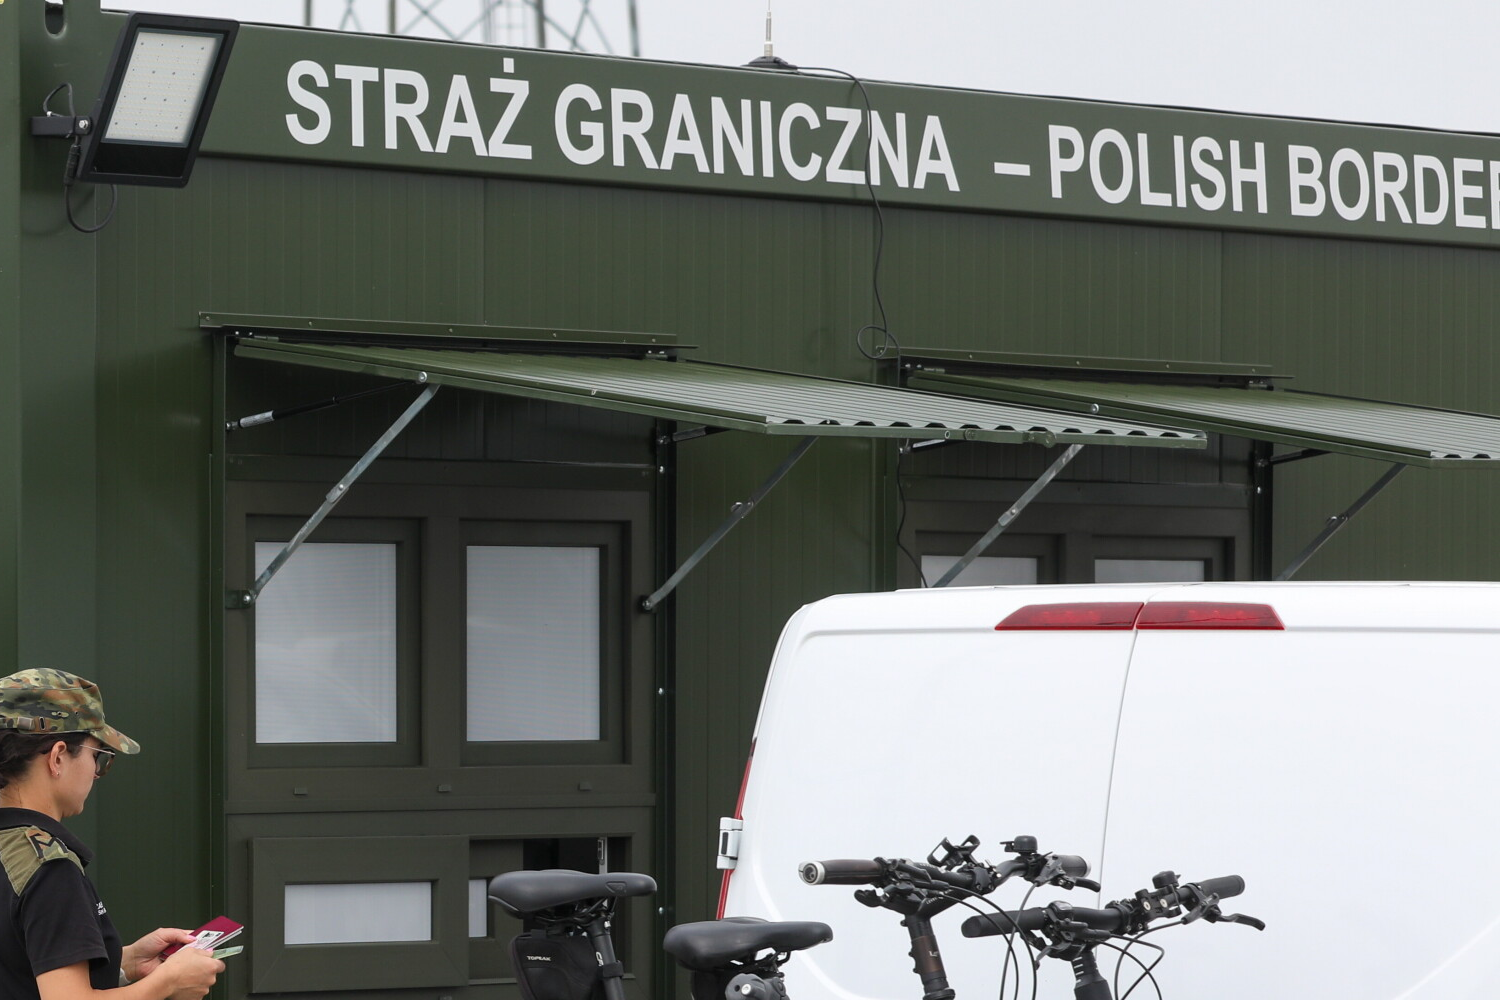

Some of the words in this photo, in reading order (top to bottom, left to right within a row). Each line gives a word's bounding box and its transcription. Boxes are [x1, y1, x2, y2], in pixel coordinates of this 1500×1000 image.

[285, 58, 533, 160] STRAŻ
[554, 83, 961, 192] GRANICZNA
[1048, 124, 1268, 214] POLISH
